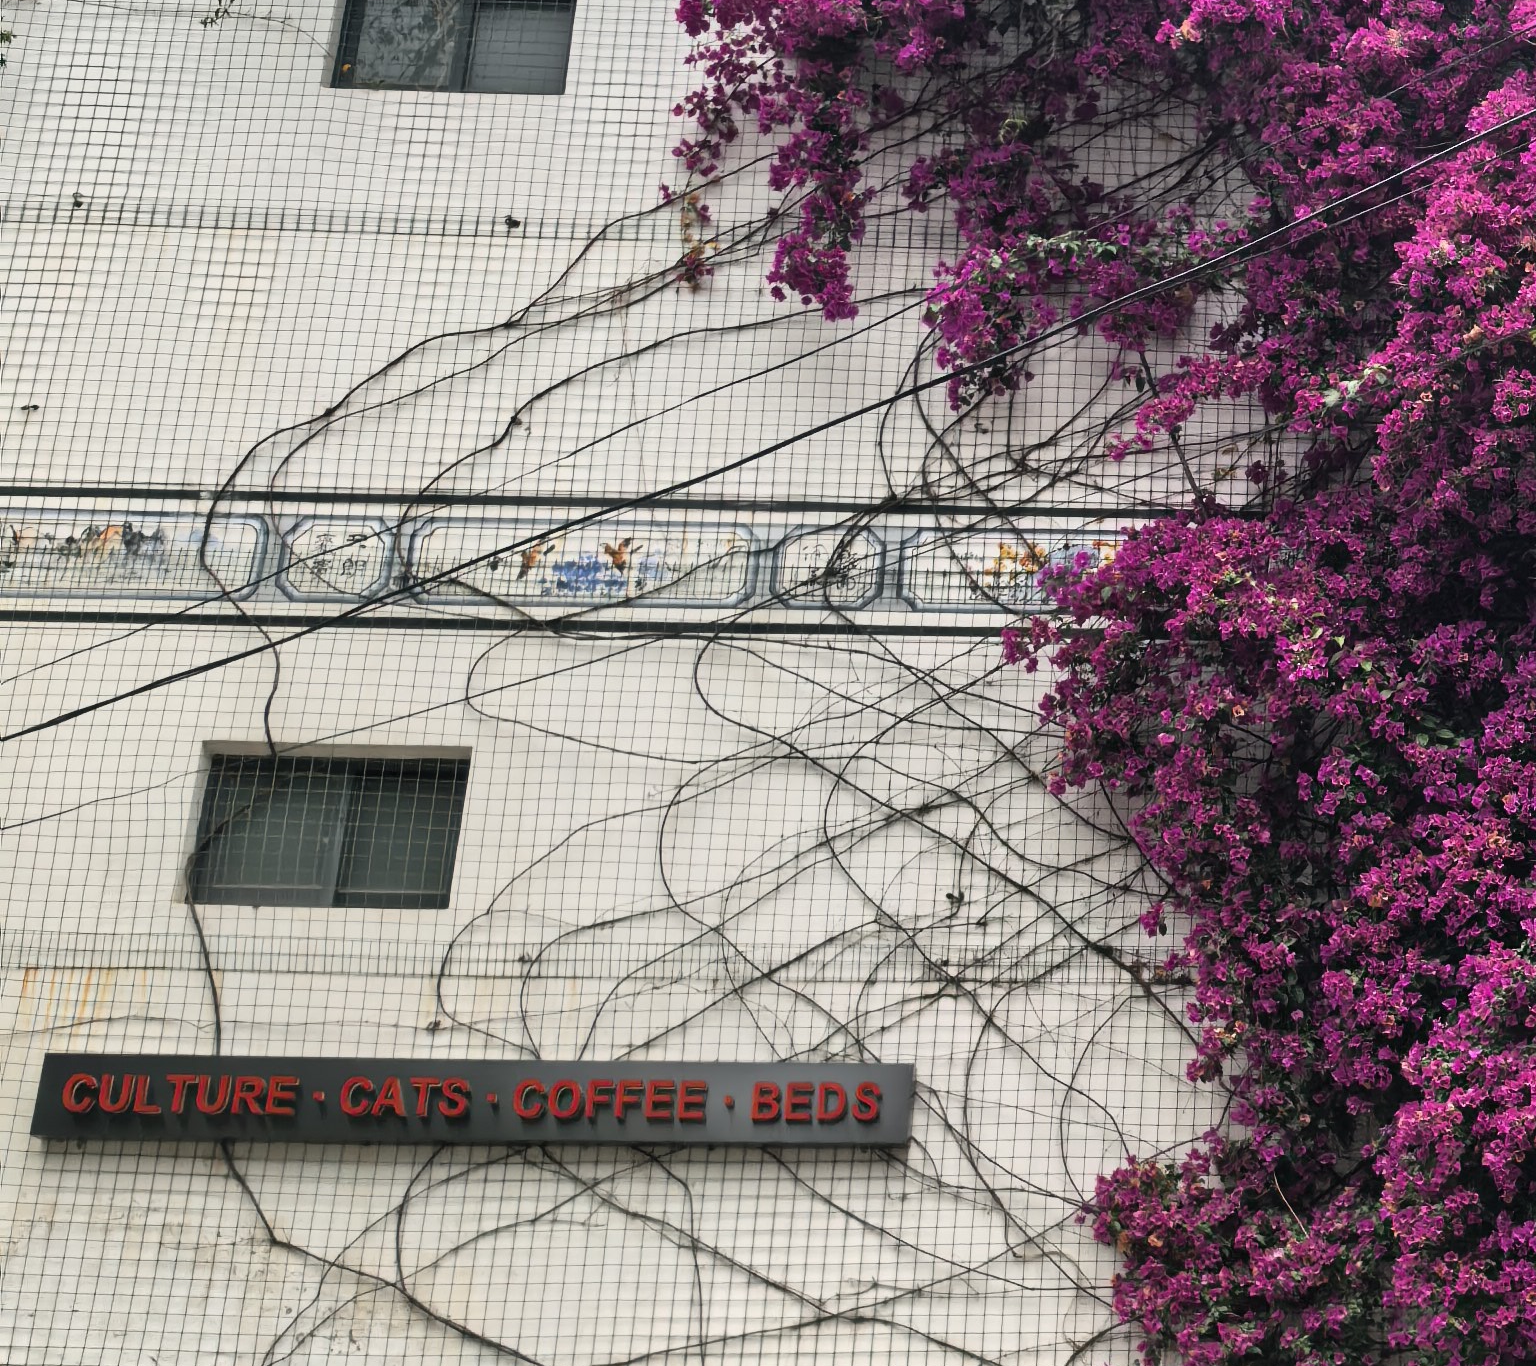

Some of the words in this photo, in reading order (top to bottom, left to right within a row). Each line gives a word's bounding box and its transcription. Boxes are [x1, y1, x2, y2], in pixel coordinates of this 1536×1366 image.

[62, 1073, 300, 1116] CULTURE
[339, 1076, 470, 1117] CATS
[512, 1078, 708, 1121] COFFEE
[750, 1081, 883, 1123] BEDS
